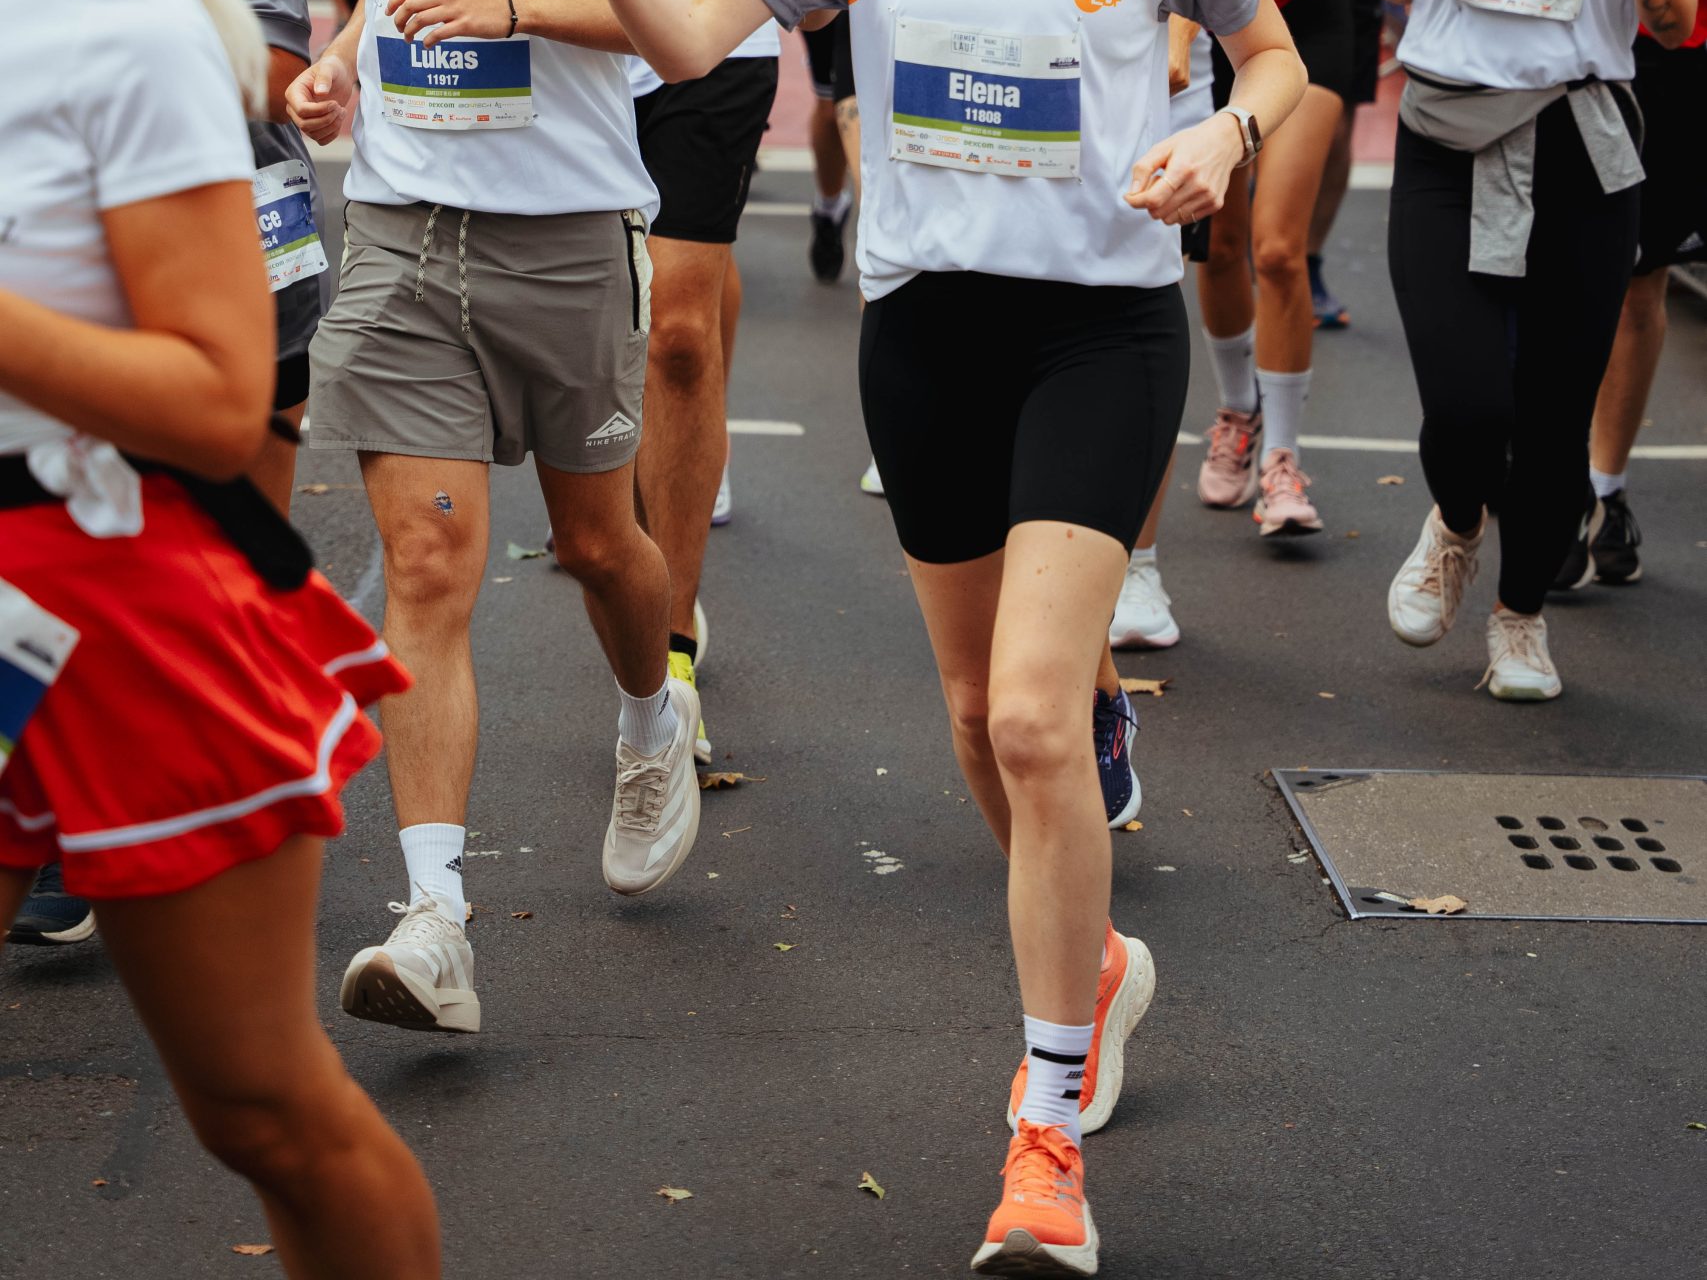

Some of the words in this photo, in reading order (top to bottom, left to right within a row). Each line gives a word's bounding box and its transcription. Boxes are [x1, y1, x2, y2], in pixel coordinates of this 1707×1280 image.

[953, 41, 976, 52] LAUF
[411, 44, 479, 69] Lukas
[427, 74, 460, 86] 11917
[949, 72, 1021, 108] Elena
[964, 107, 1002, 124] 11808
[257, 210, 282, 234] ce
[585, 439, 610, 447] NIKE
[612, 430, 635, 443] TRAIL
